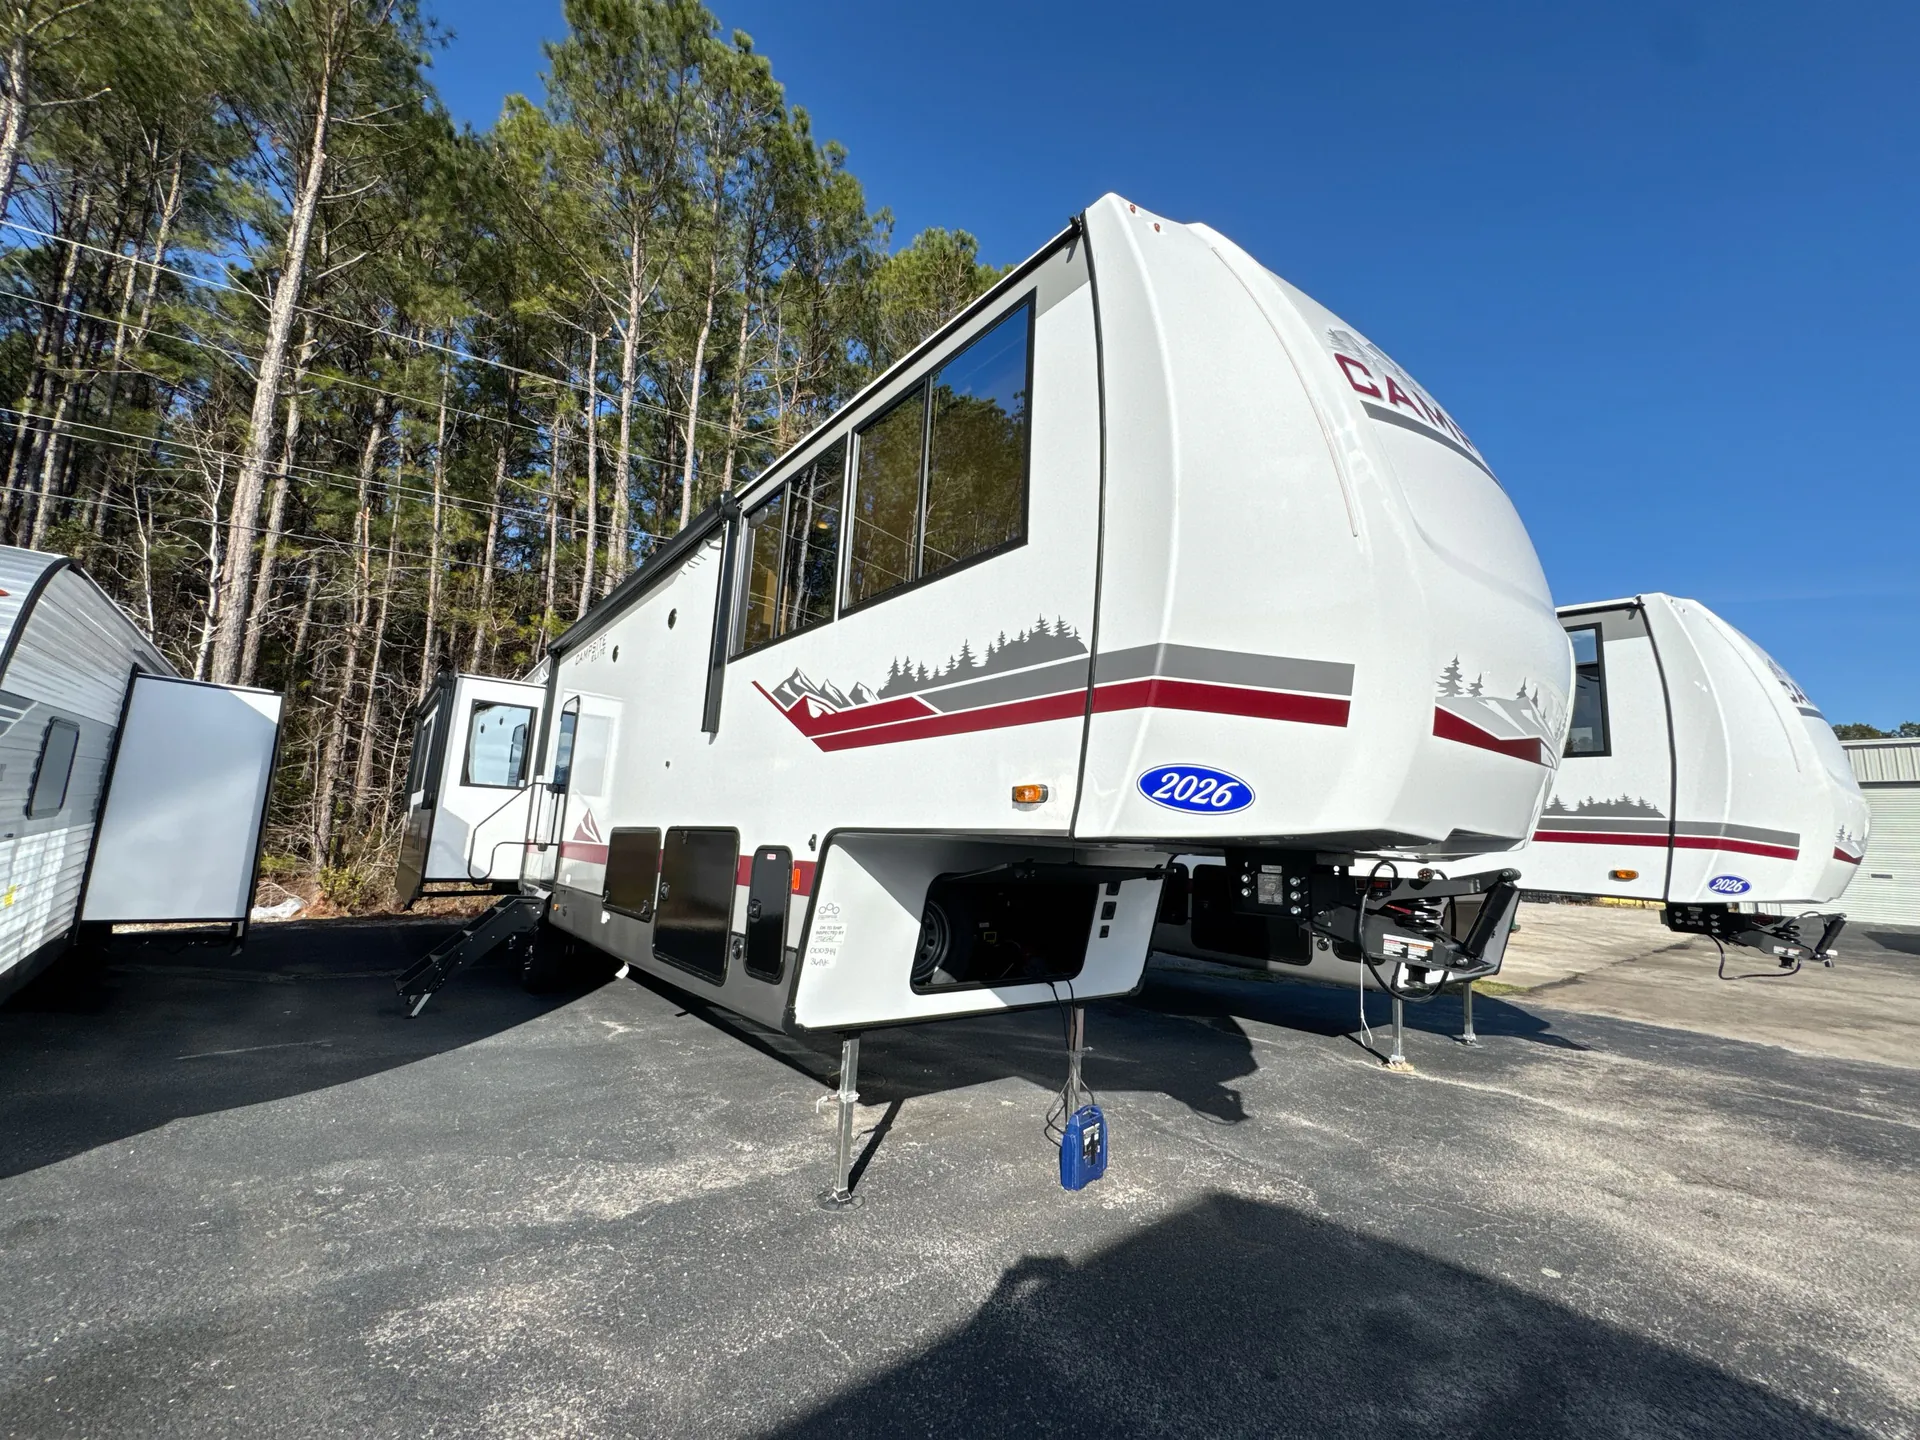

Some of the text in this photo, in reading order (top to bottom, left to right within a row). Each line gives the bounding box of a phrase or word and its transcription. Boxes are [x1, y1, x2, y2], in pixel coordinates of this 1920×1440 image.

[575, 633, 607, 665] CAMPSITE
[1152, 772, 1240, 807] 2026
[1711, 878, 1746, 892] 2026
